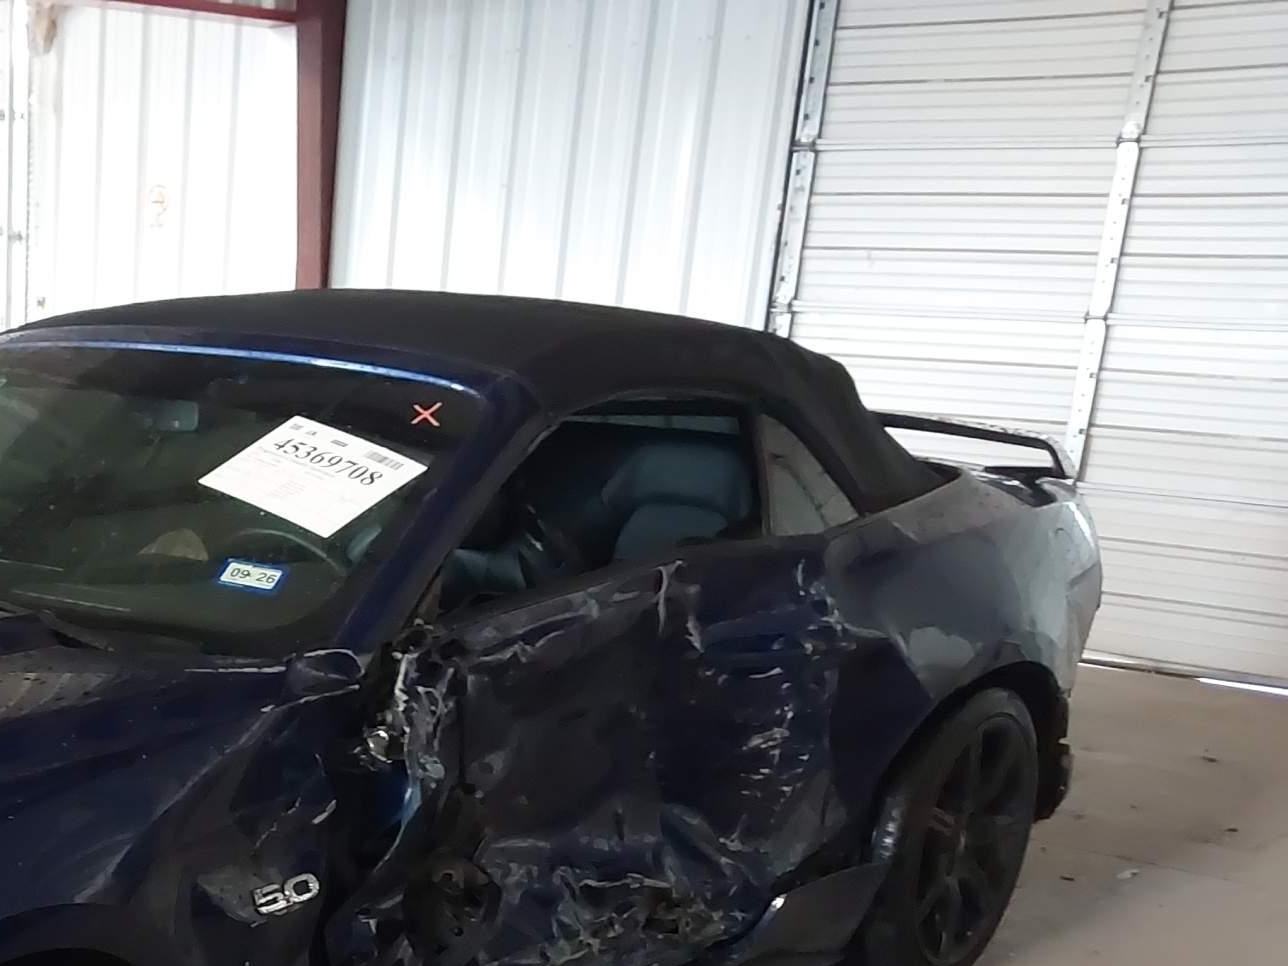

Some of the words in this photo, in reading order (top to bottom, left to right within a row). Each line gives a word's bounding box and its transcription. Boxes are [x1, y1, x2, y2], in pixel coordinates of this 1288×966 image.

[273, 438, 383, 486] 45369708
[230, 567, 251, 579] 09
[255, 572, 277, 584] 26
